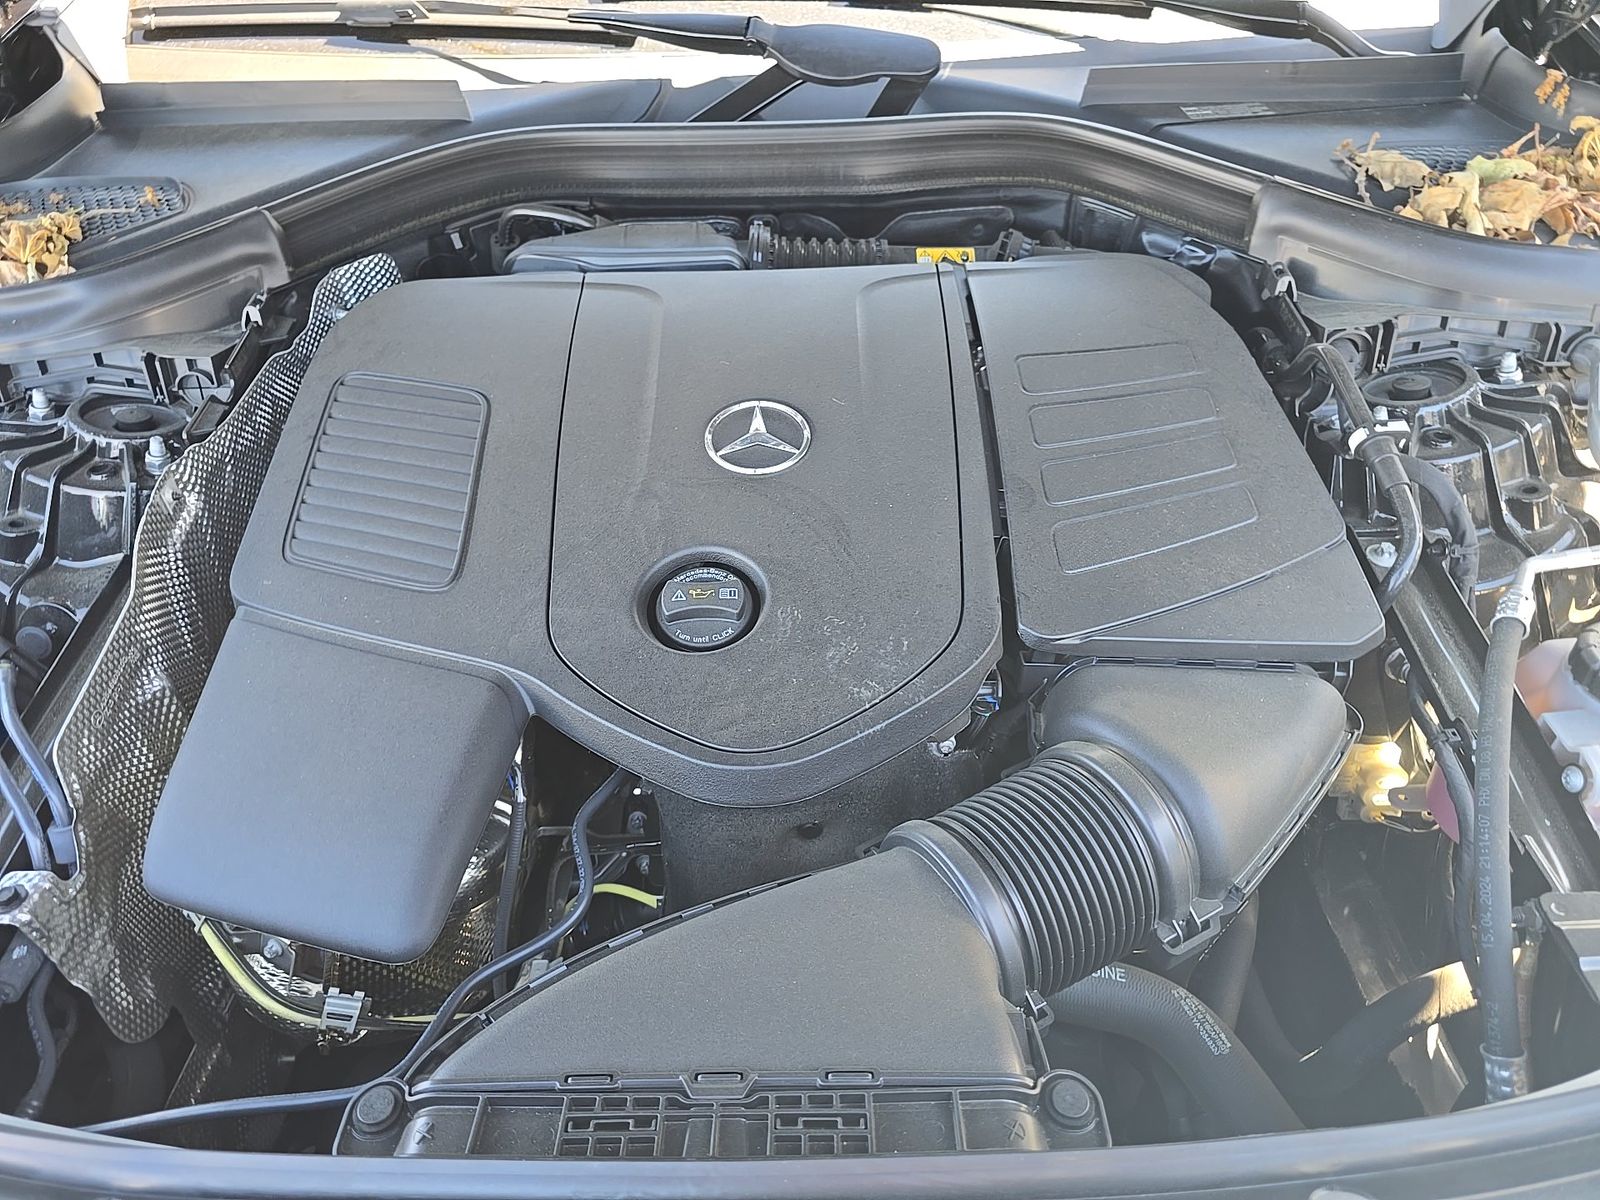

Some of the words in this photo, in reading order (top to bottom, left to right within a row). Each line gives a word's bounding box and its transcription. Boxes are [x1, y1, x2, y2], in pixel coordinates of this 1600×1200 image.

[675, 629, 691, 641] Turn
[692, 635, 709, 643] until
[712, 626, 735, 641] CLICK
[1478, 786, 1491, 808] PHX
[1479, 814, 1491, 869] 21:14:07
[1480, 876, 1494, 949] 15.04.2024
